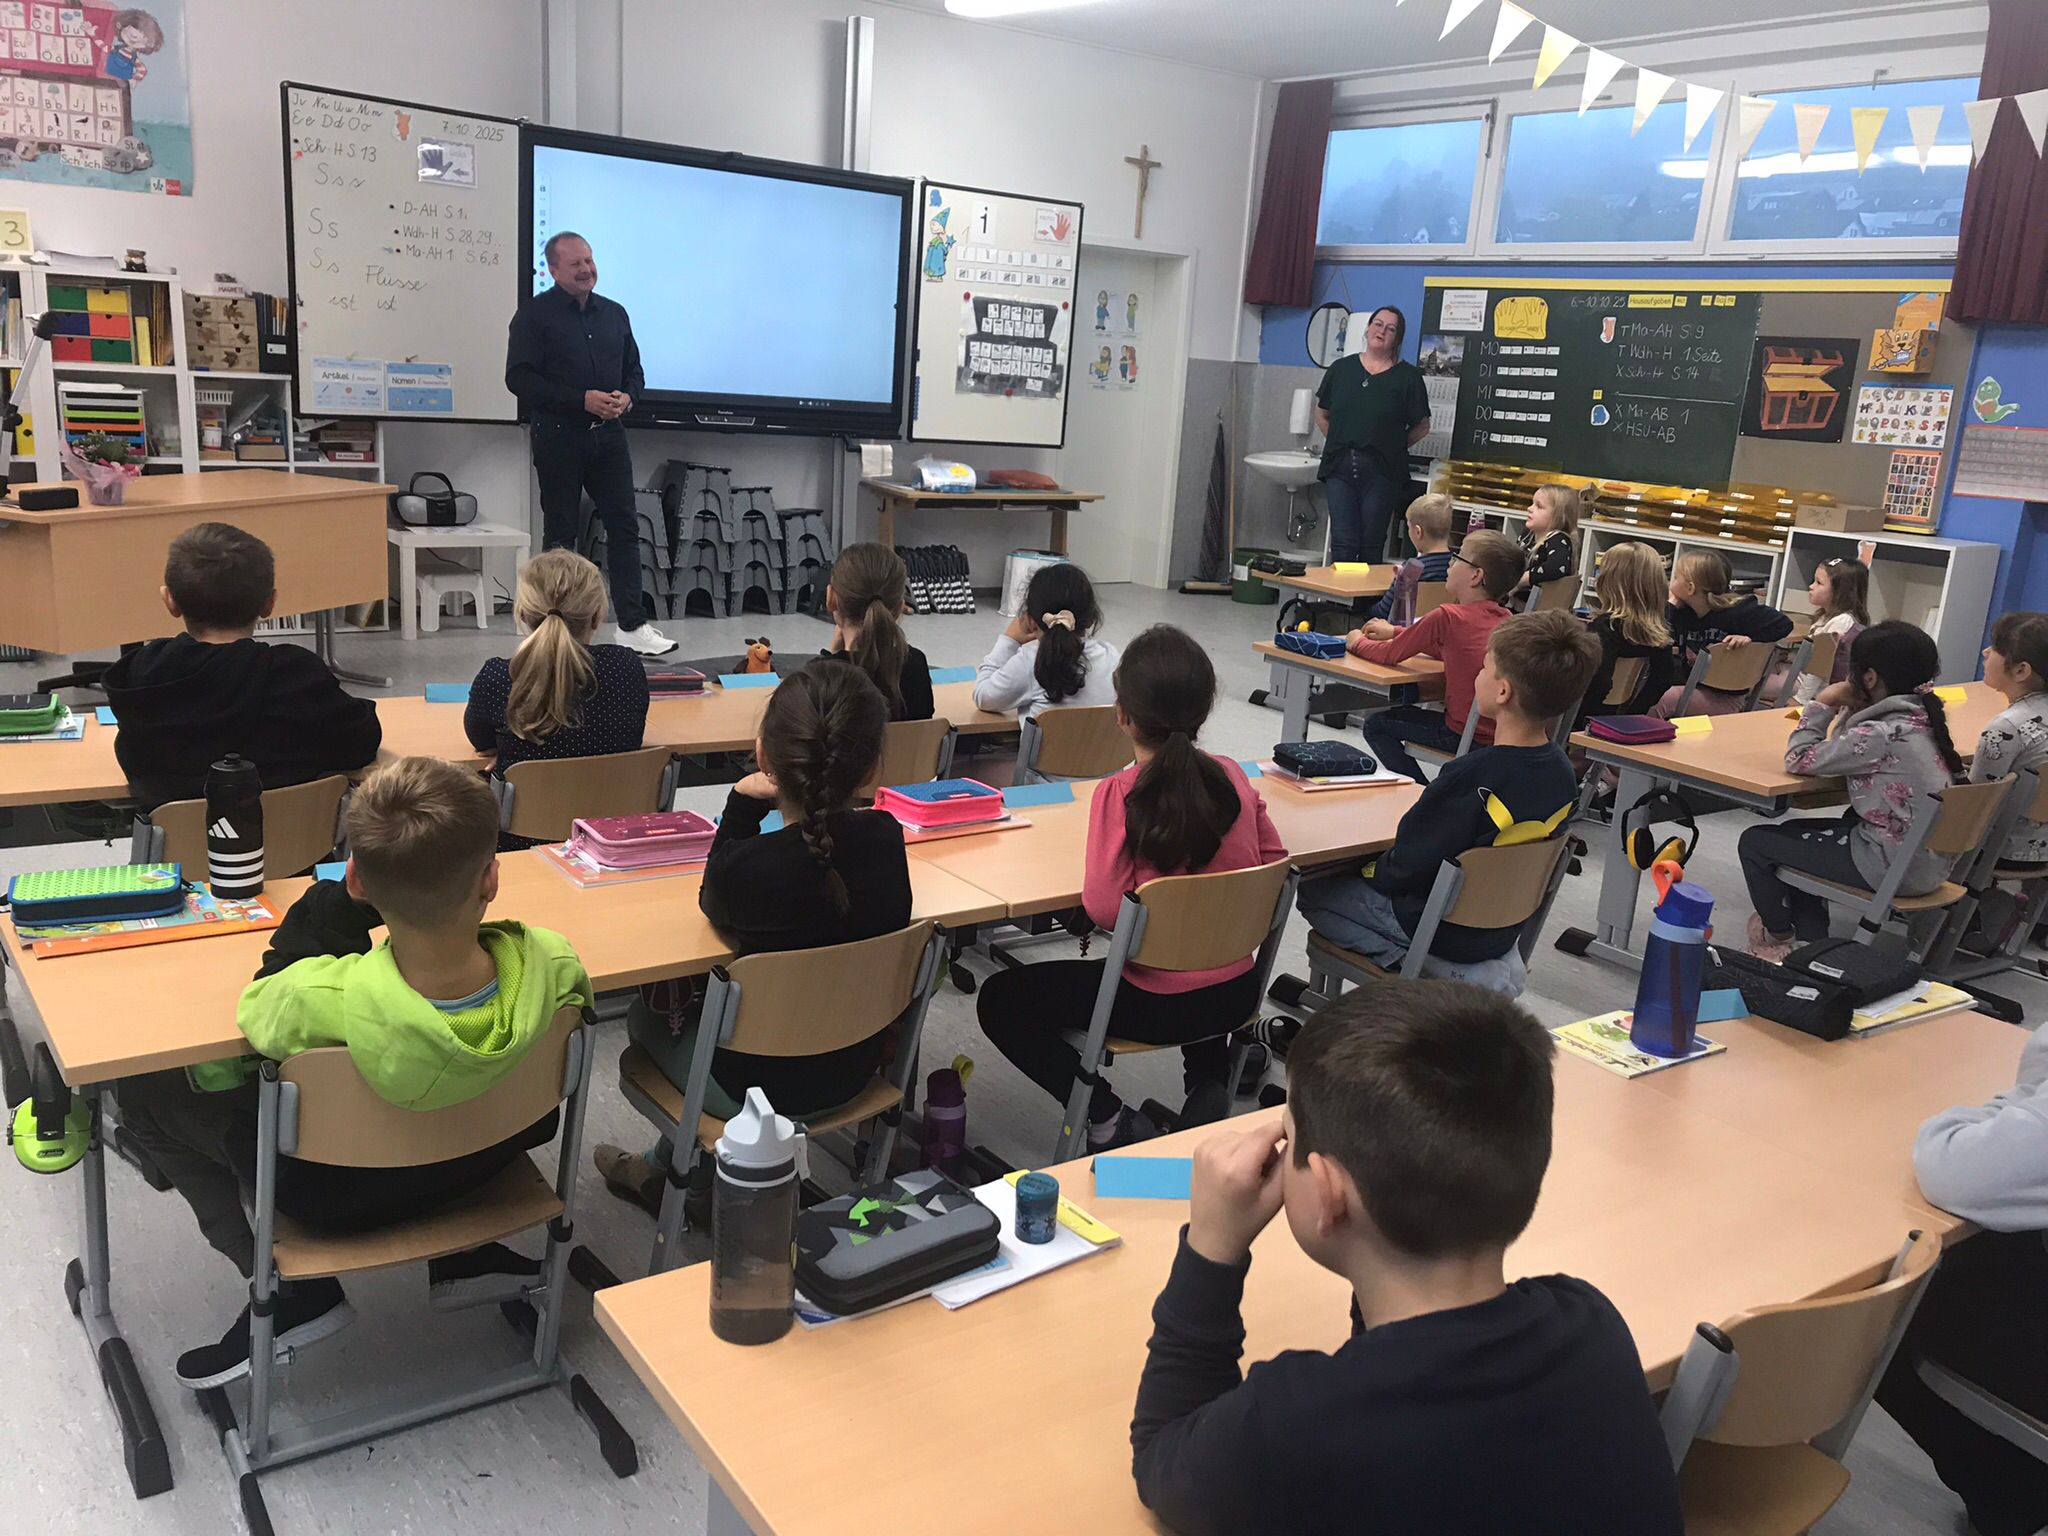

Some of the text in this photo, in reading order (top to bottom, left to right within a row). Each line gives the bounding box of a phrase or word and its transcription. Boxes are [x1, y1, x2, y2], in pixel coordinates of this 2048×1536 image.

[475, 126, 505, 142] 2025
[61, 153, 80, 165] Sch
[347, 143, 356, 158] S
[360, 146, 377, 162] 13
[403, 201, 438, 217] D-AH
[444, 205, 454, 219] S
[4, 220, 24, 247] 3
[1630, 296, 1672, 306] Hausaufgaben
[1631, 322, 1673, 338] Ma-AH
[1679, 324, 1691, 339] S
[1695, 325, 1704, 339] 9
[1480, 341, 1499, 356] MO
[1618, 344, 1626, 357] T
[1683, 346, 1691, 361] 1
[1692, 347, 1723, 363] Seite
[322, 371, 349, 381] Artikel
[1480, 363, 1492, 377] DI
[1672, 366, 1681, 380] S
[1686, 365, 1699, 379] 14
[391, 376, 417, 386] Nomen
[1477, 385, 1492, 399] MI
[1475, 405, 1492, 421] DO
[1680, 408, 1690, 424] 1
[1473, 429, 1489, 446] FR
